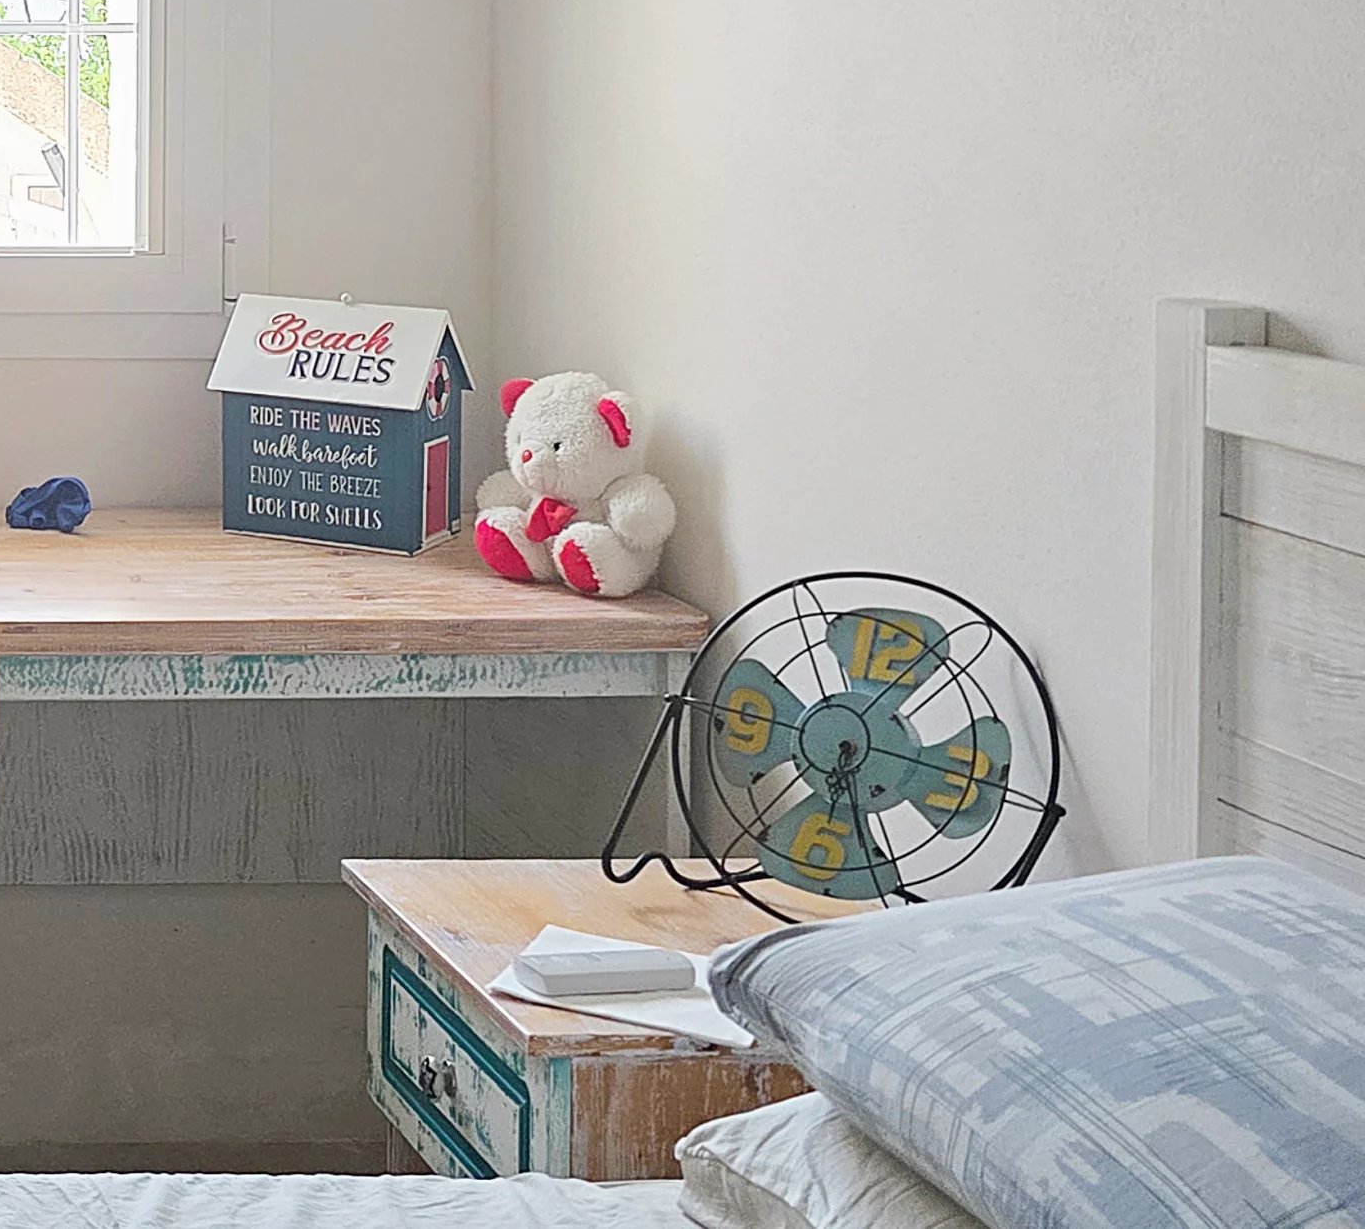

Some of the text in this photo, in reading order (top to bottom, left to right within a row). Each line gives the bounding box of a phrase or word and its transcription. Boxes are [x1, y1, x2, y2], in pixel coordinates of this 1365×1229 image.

[258, 313, 394, 355] Beach
[287, 349, 395, 384] RULES
[249, 404, 381, 437] RIDE THE WAVES
[253, 434, 378, 469] walk barefoot
[249, 465, 382, 499] ENJOY THE BREEZE
[246, 494, 382, 530] LOOK FOR SHELLS
[847, 616, 926, 686] 12
[724, 686, 775, 755] 9
[924, 744, 991, 812] 3
[789, 812, 852, 881] 6
